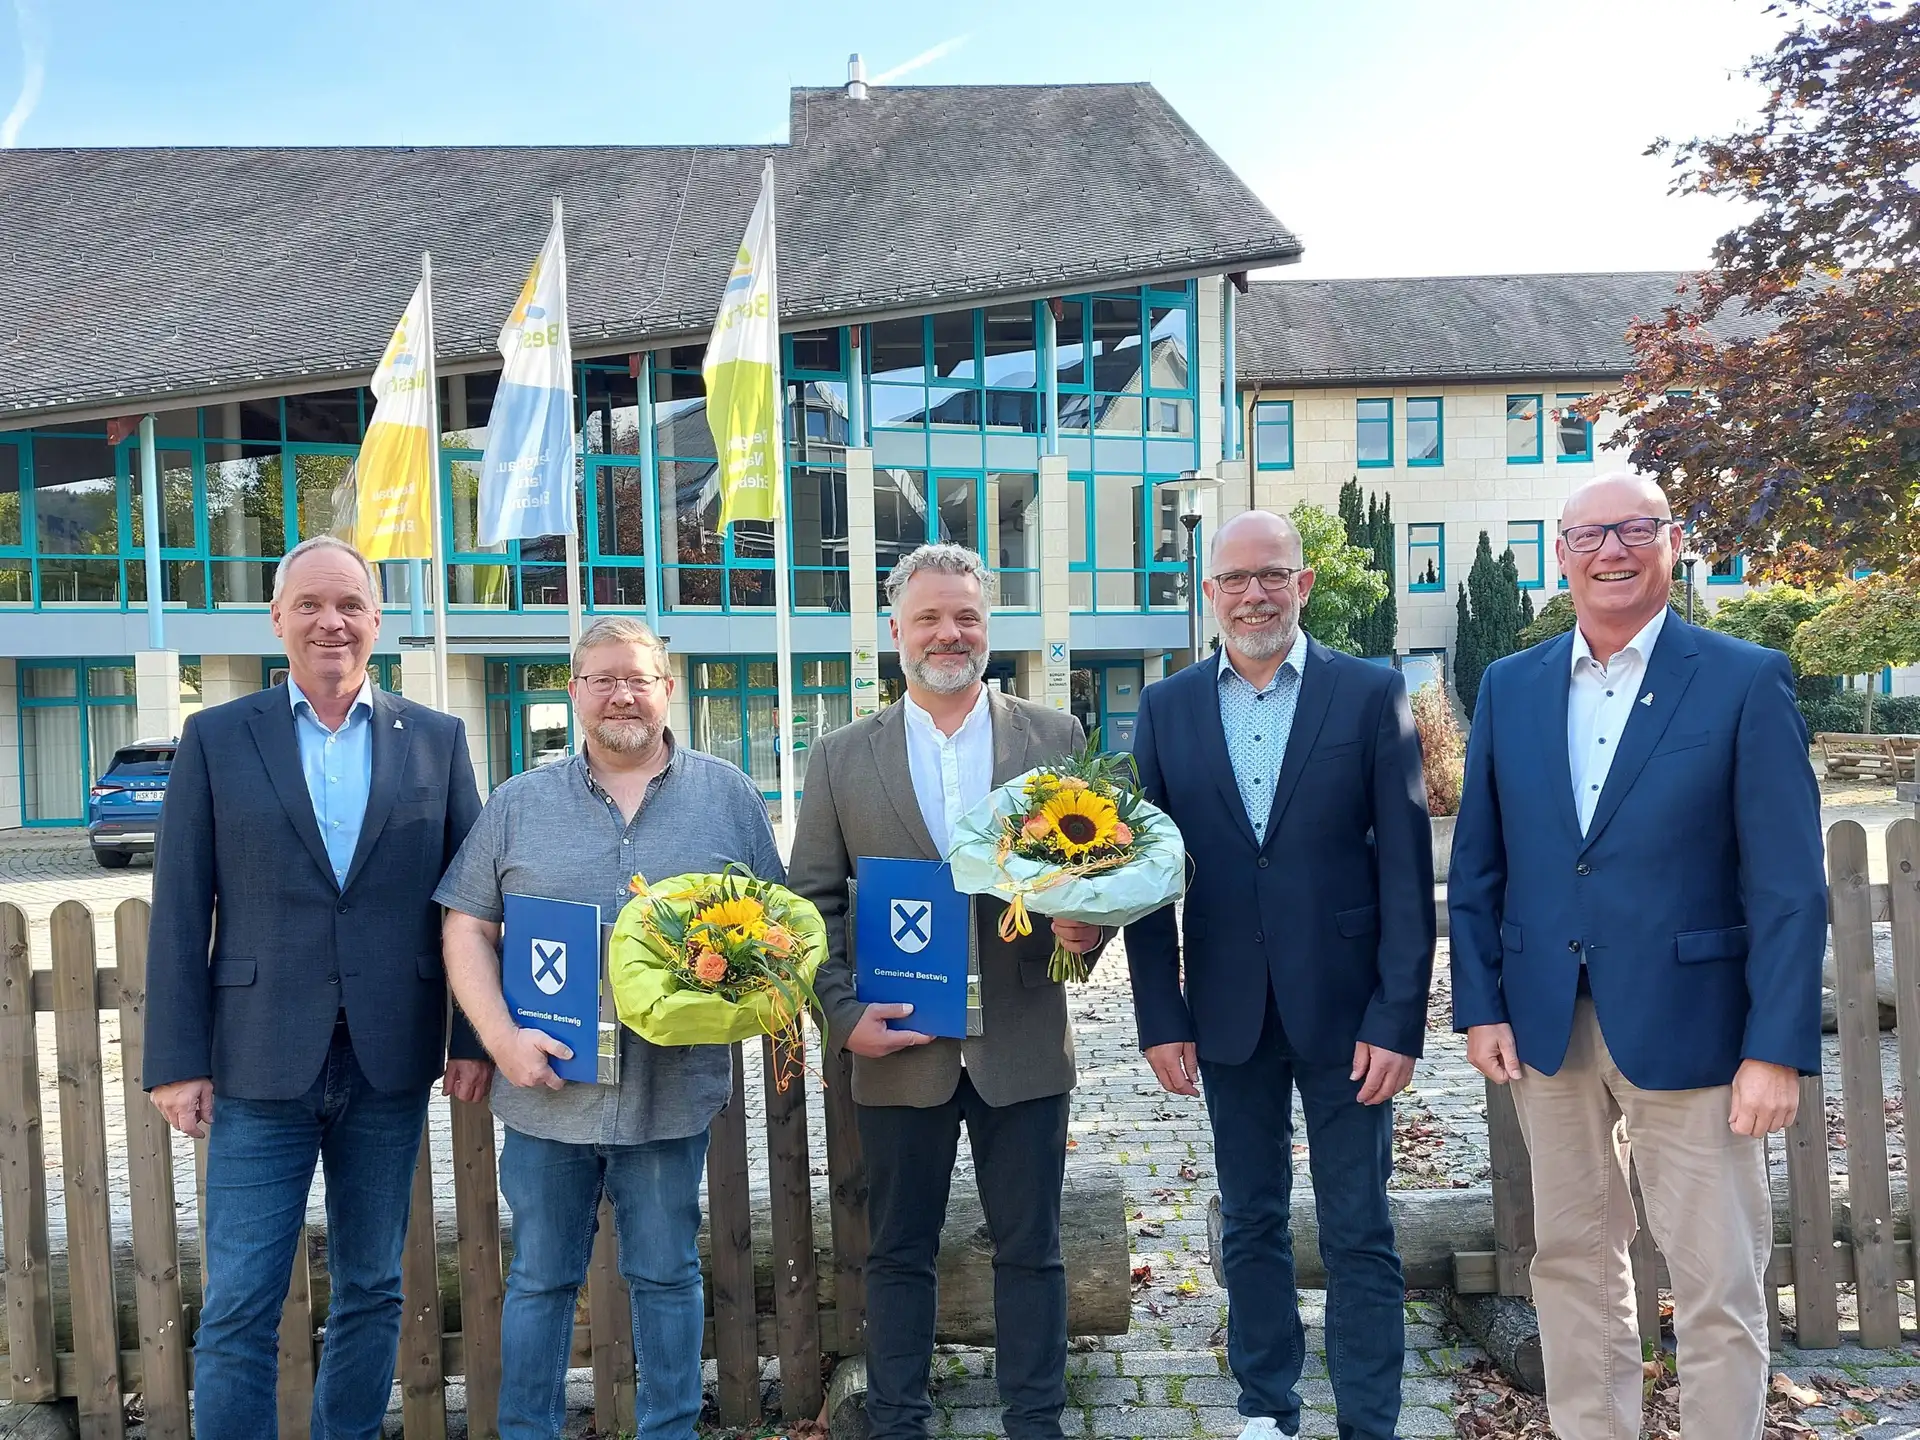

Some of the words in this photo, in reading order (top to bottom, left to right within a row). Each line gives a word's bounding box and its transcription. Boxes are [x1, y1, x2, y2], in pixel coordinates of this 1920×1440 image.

[874, 968, 914, 978] Gemeinde
[916, 972, 948, 983] Bestwig
[517, 1008, 552, 1020] Gemeinde
[553, 1014, 582, 1027] Bestwig
